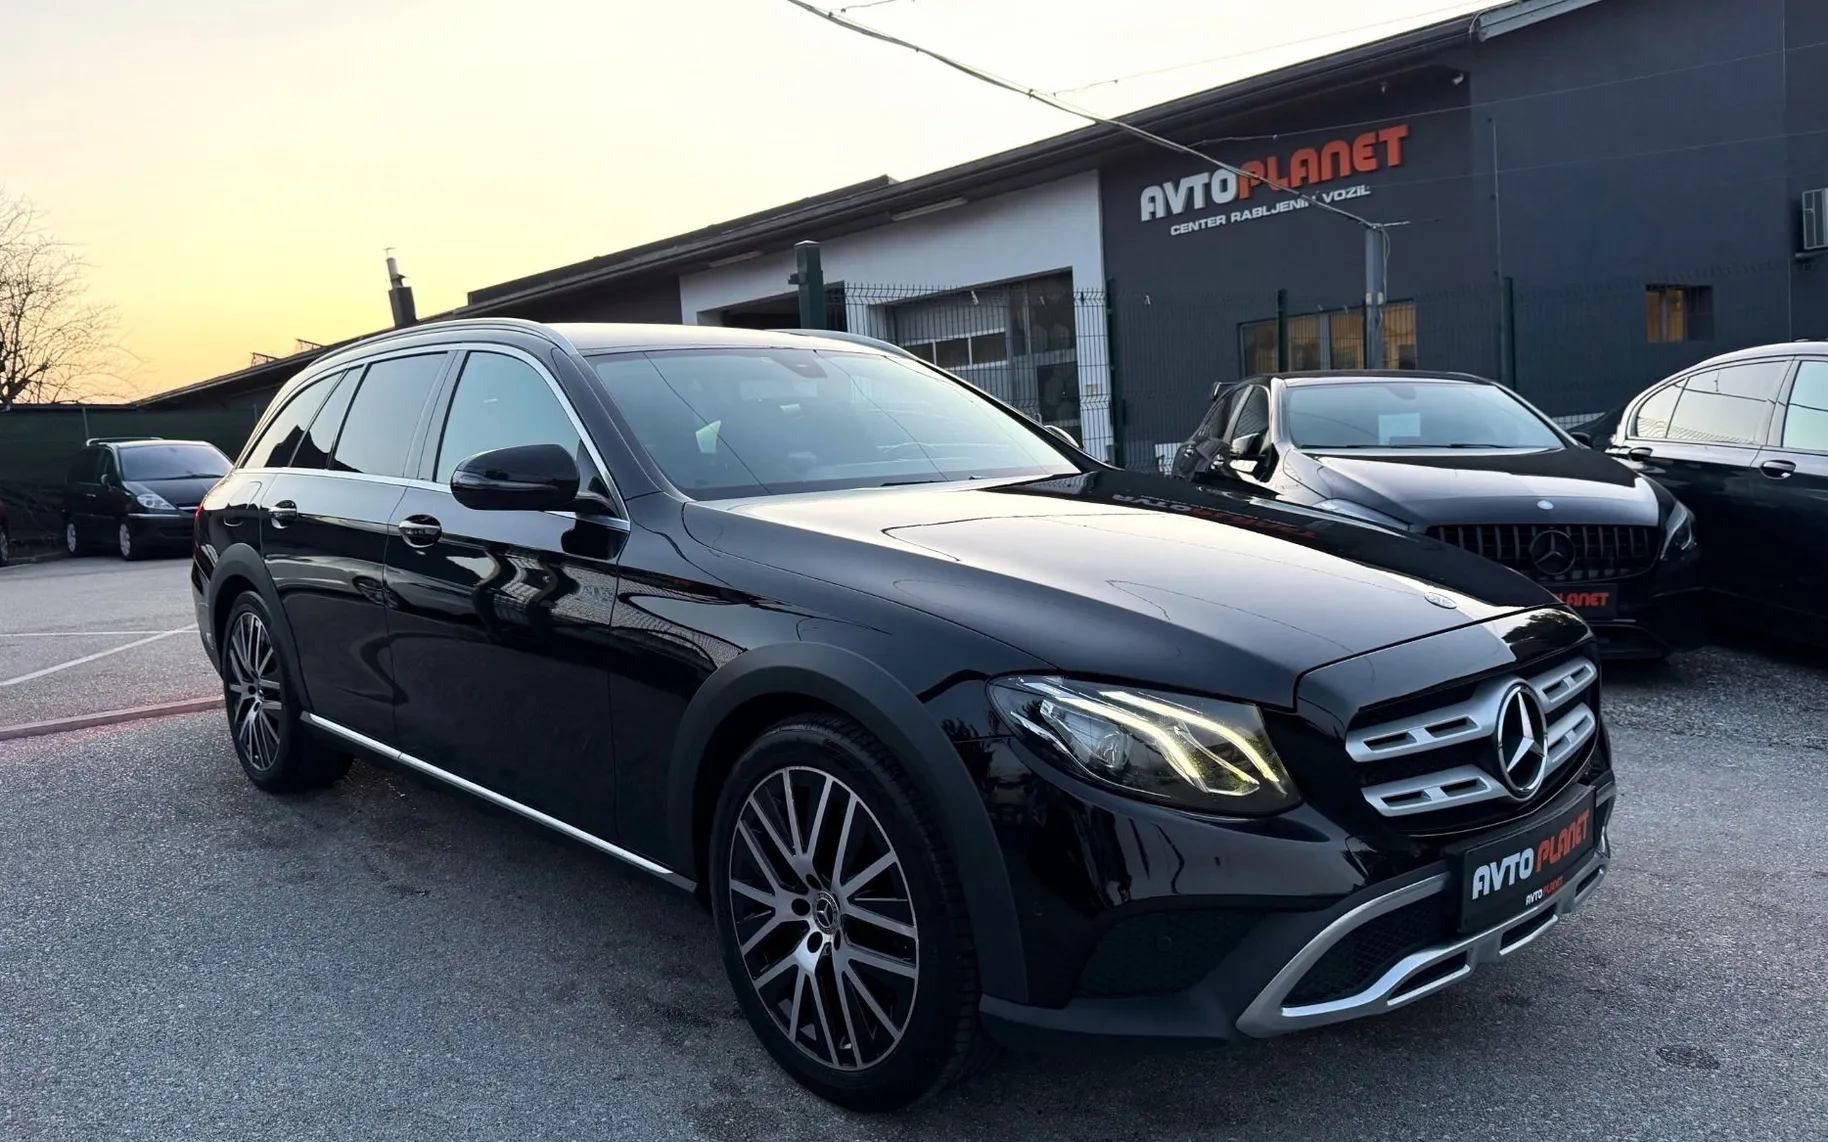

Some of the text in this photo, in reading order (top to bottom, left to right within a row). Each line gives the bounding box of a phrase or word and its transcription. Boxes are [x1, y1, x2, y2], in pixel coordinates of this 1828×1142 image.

[1171, 213, 1226, 235] CENTER
[1322, 185, 1371, 203] VOZIL
[1472, 809, 1590, 900] AVTO PLANET
